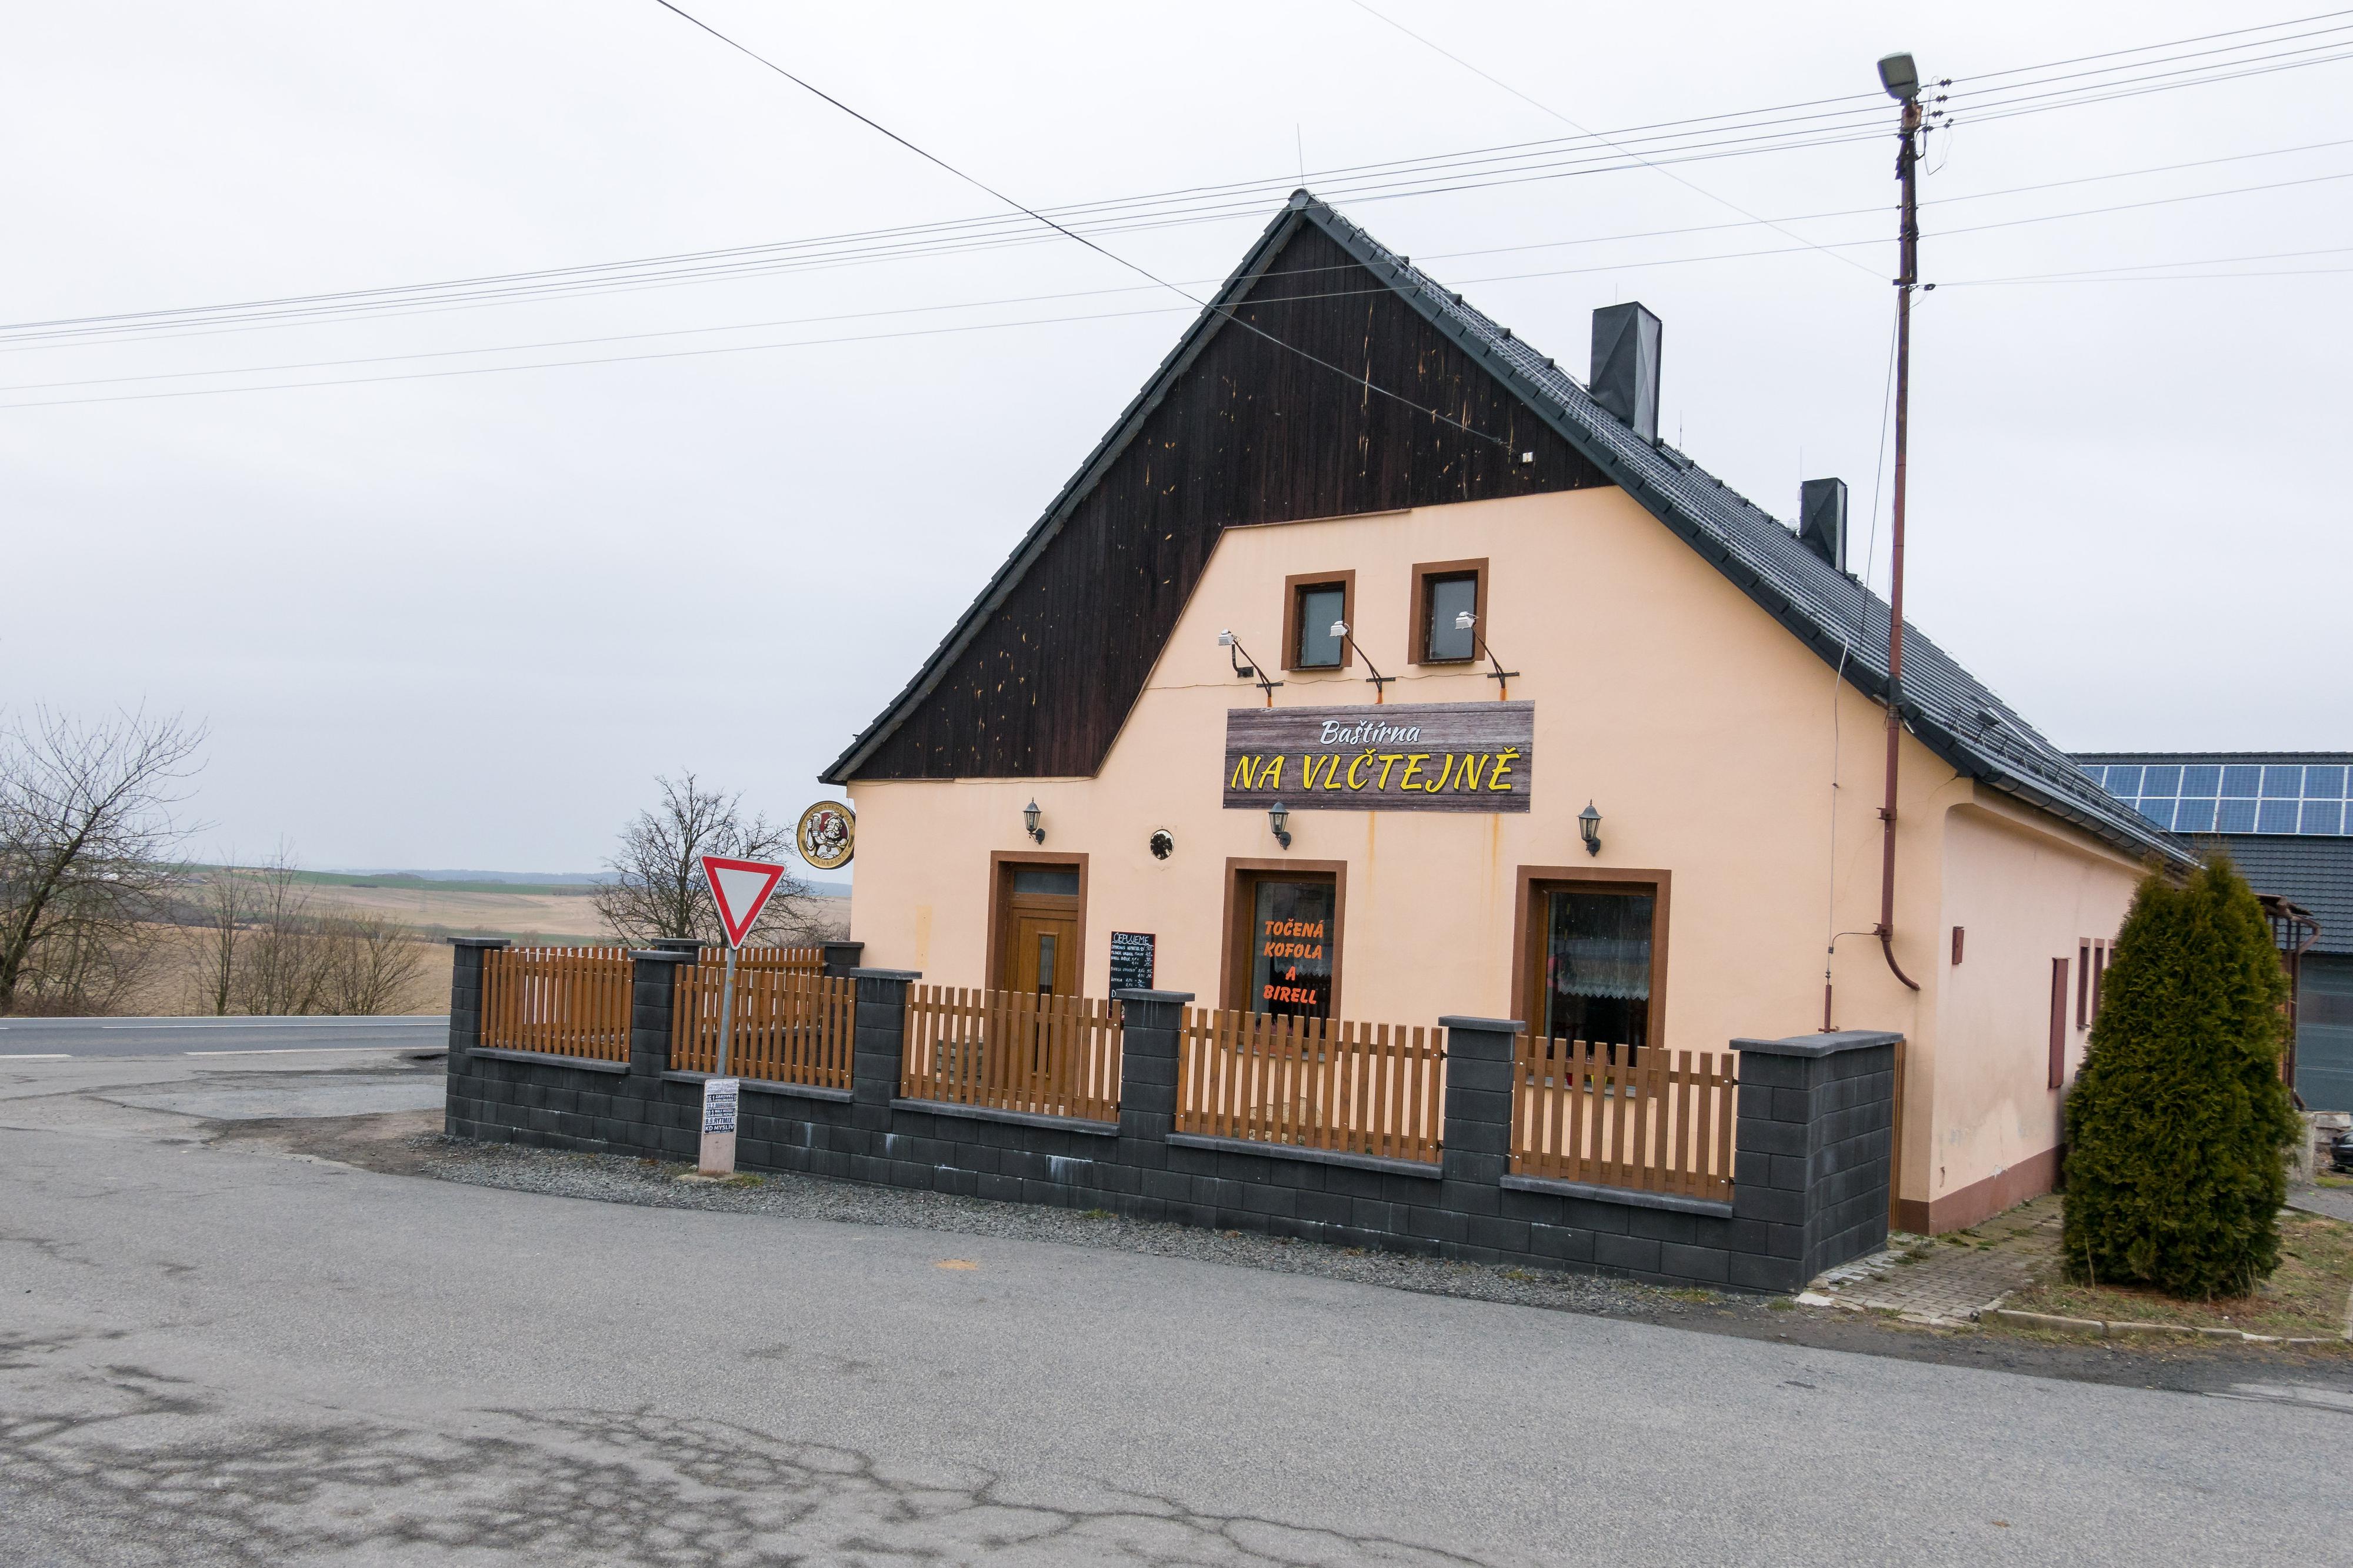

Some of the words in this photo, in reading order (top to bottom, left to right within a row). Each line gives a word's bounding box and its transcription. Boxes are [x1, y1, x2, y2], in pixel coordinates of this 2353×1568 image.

[1319, 719, 1421, 745] Baštírna
[1231, 754, 1286, 790] NA
[1302, 746, 1521, 793] VLČTEJNĚ
[1265, 918, 1324, 938] TOČENÁ
[1114, 932, 1149, 945] ČEPUJEME
[1264, 941, 1322, 960] KOFOLA
[1285, 966, 1296, 981] A
[1263, 985, 1317, 1005] BIRELL
